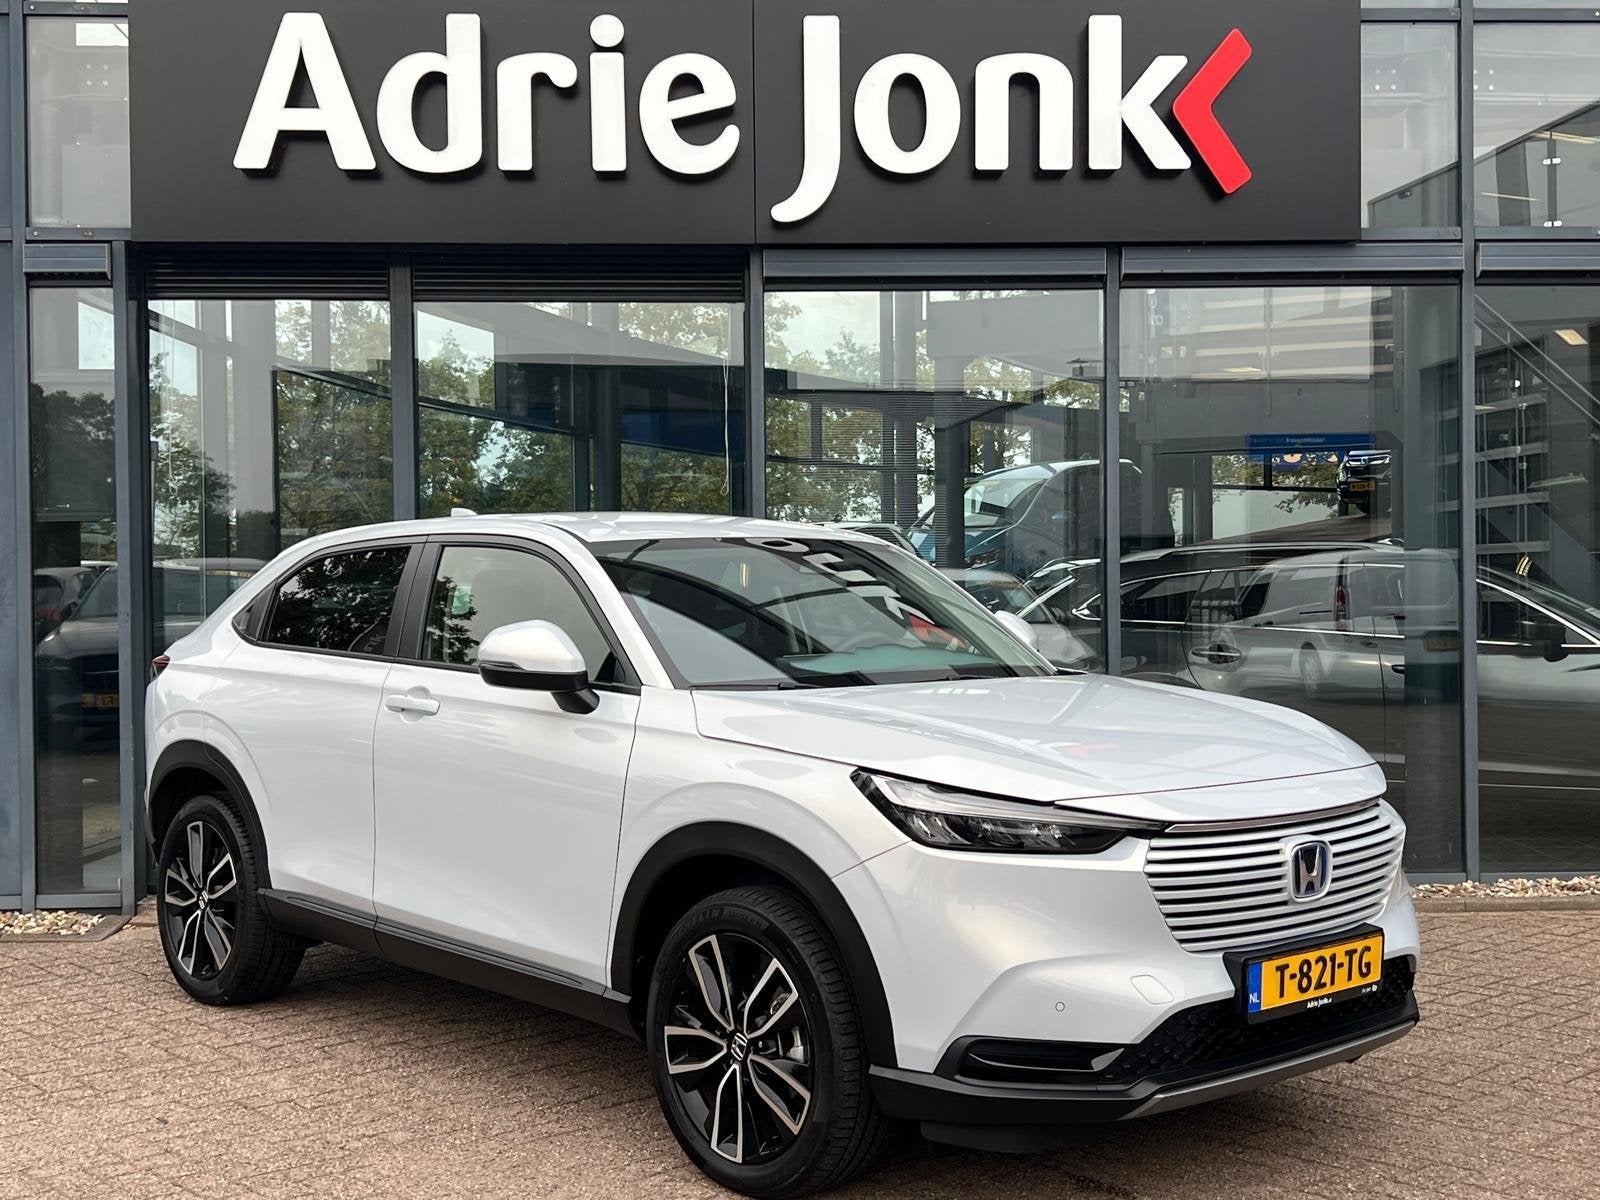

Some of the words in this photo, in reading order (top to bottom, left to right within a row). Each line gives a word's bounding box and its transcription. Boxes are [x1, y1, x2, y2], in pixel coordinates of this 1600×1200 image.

[233, 12, 740, 176] Adrie
[771, 14, 1192, 223] Jonk
[1249, 993, 1260, 1004] NL
[1275, 945, 1372, 999] T-821-TG
